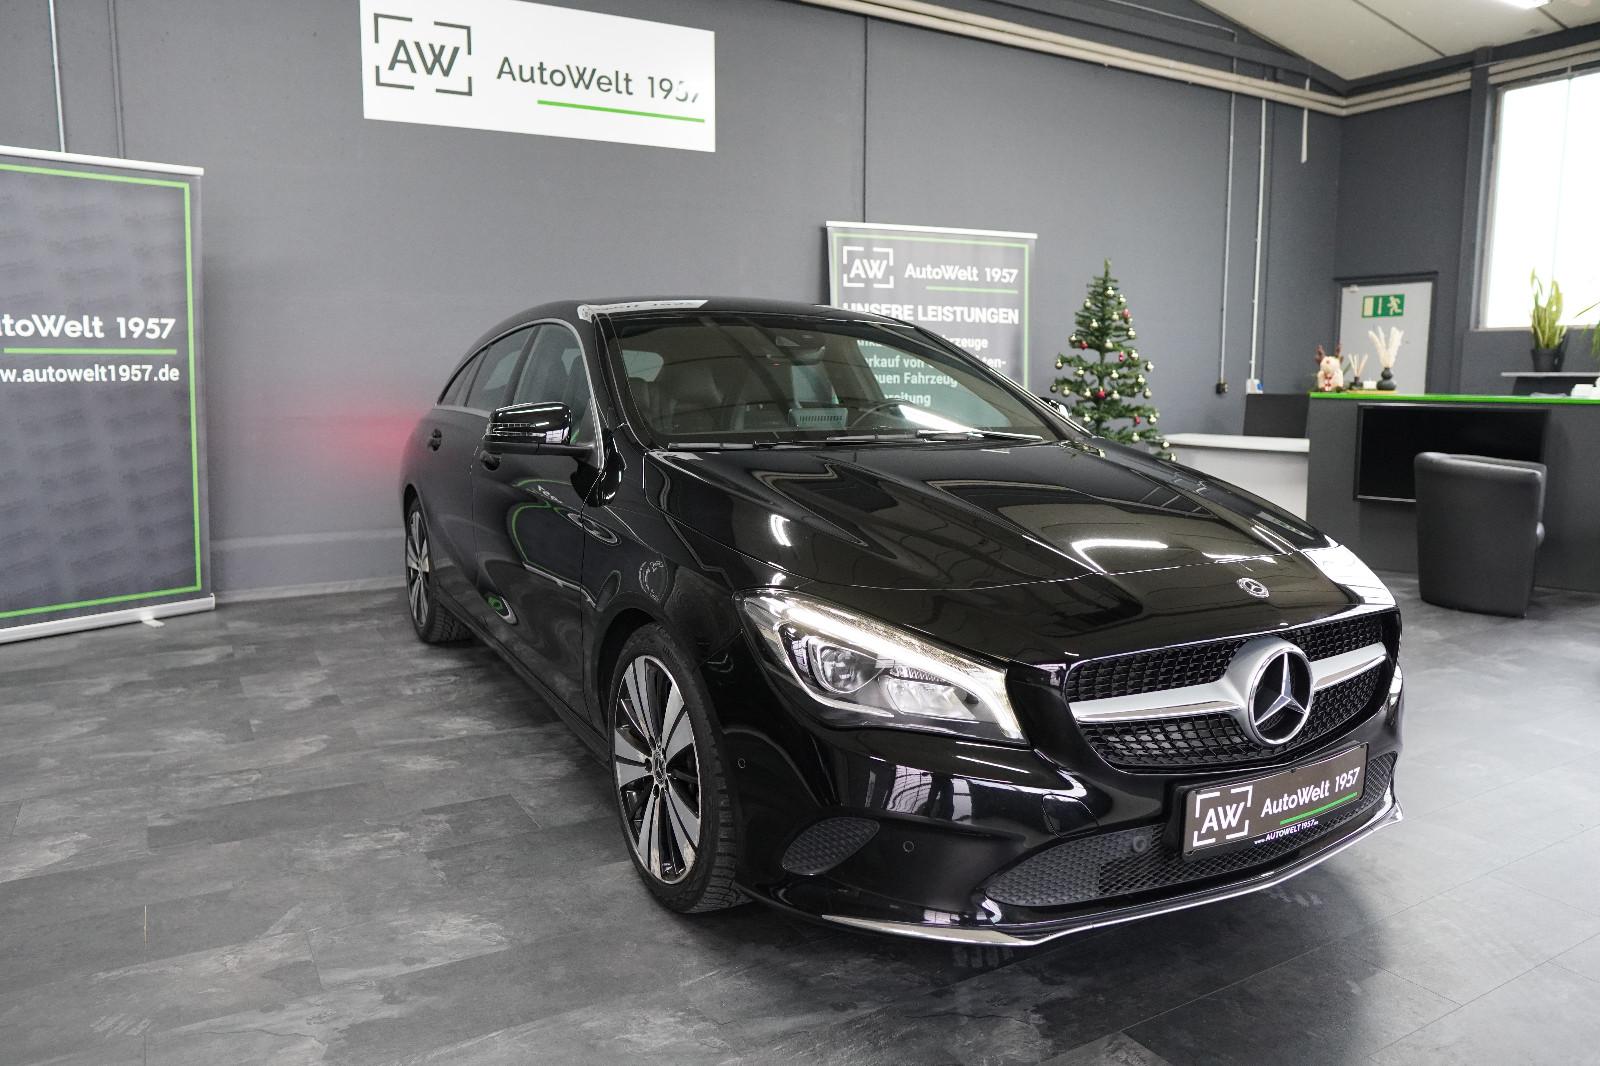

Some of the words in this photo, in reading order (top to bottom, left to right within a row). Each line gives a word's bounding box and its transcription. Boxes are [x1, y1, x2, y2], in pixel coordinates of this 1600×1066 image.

[388, 39, 460, 77] AW
[496, 56, 634, 96] AutoWelt
[849, 258, 888, 279] AW
[904, 263, 978, 282] AutoWelt
[984, 267, 1018, 283] 1957
[0, 313, 104, 339] toWelt
[117, 316, 176, 339] 1957
[917, 304, 1019, 325] LEISTUNGEN
[865, 355, 900, 368] rkauf
[903, 358, 924, 368] von
[875, 374, 900, 384] uen
[1260, 779, 1330, 818] AutoWelt
[1334, 766, 1361, 793] 1957
[1201, 801, 1245, 834] AW
